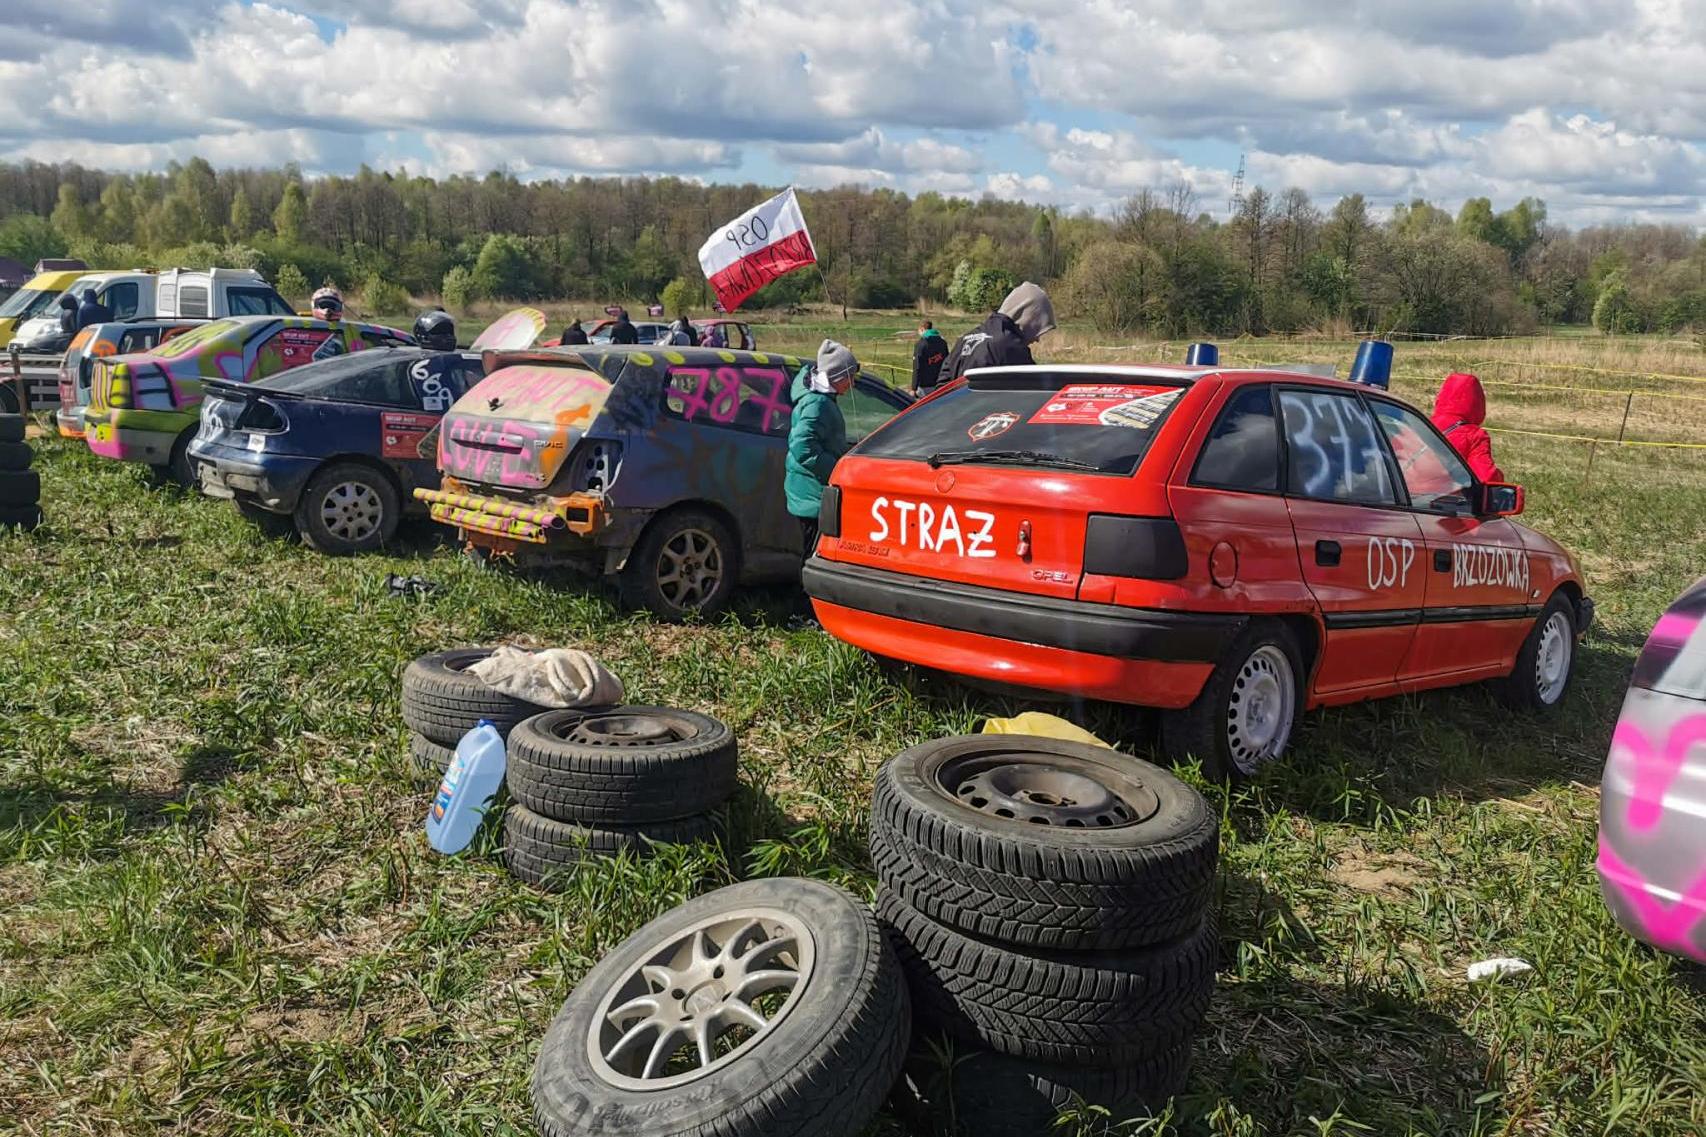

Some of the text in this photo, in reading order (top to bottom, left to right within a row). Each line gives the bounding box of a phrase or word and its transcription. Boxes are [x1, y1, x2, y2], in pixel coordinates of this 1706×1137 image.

[664, 364, 792, 433] 787
[1032, 569, 1074, 585] OPEL
[1367, 536, 1415, 590] OSP
